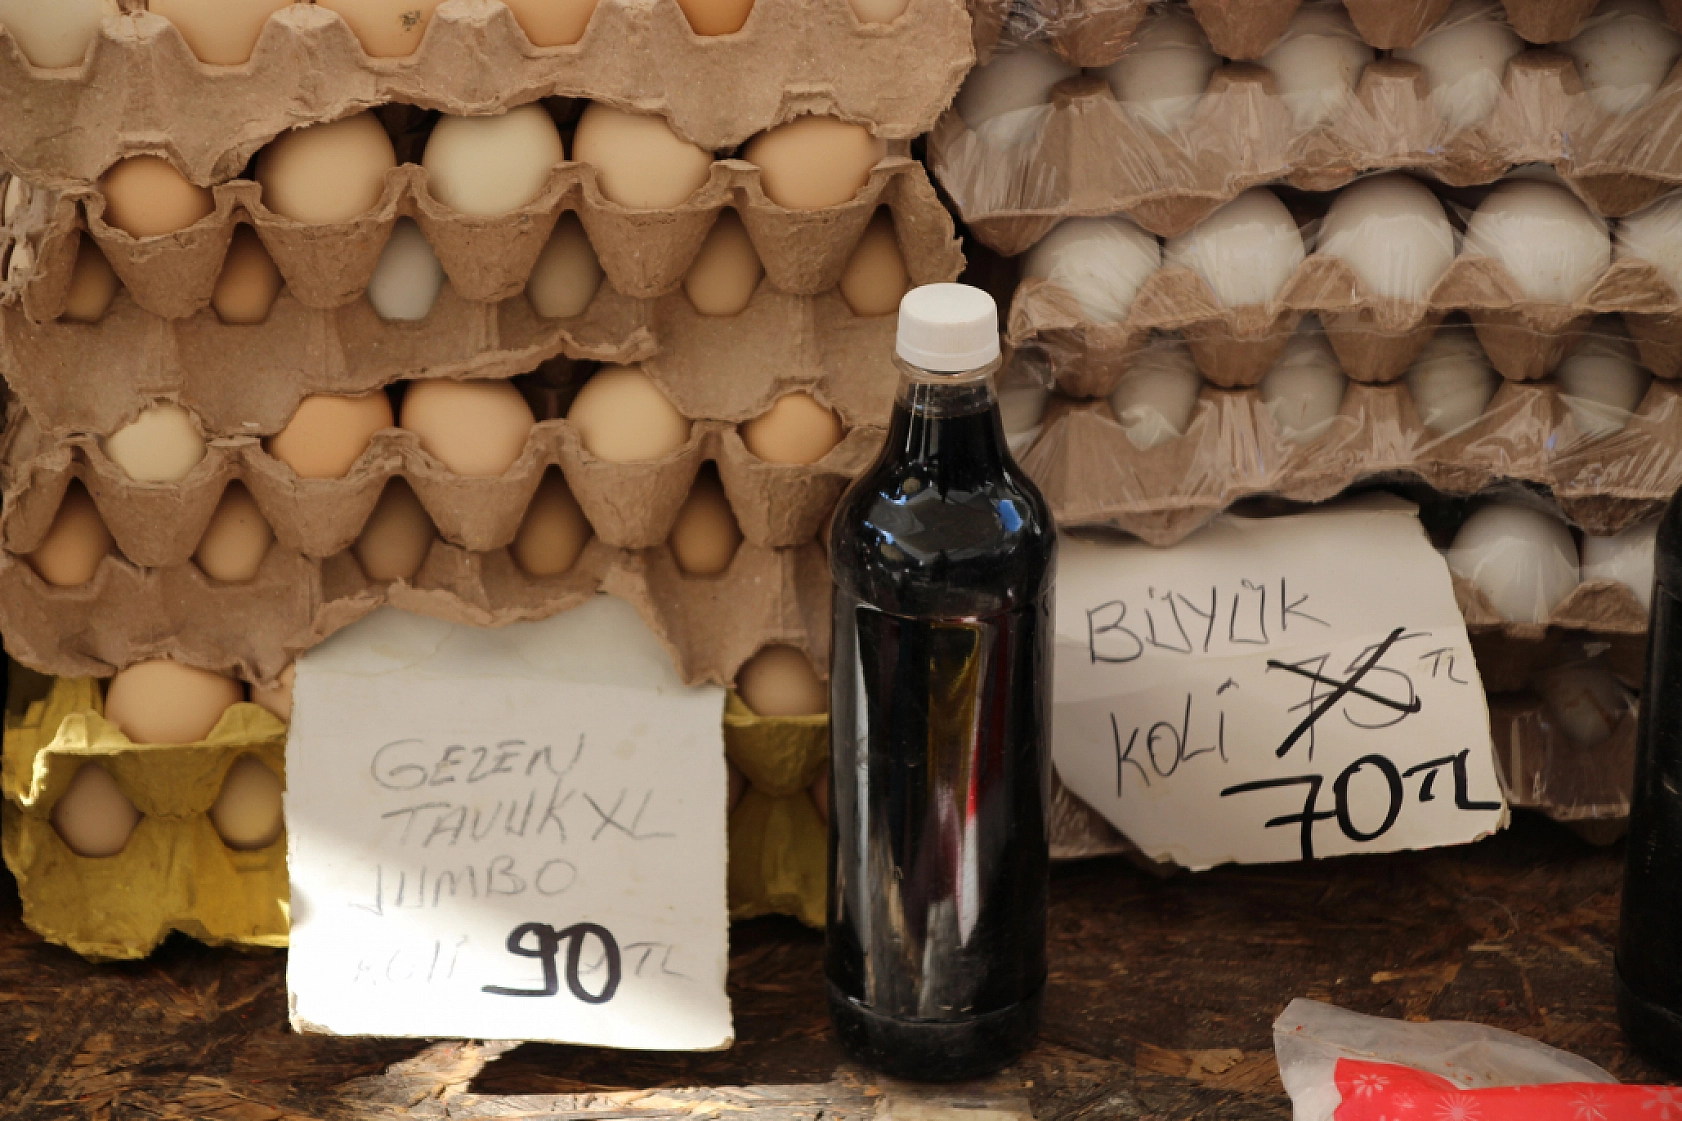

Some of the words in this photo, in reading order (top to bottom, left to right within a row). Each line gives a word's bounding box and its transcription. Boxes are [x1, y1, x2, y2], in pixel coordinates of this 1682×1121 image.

[1087, 577, 1331, 664] BÜYÜK
[371, 732, 585, 791] GEZEN
[381, 777, 576, 848] TAVUK
[582, 788, 676, 841] XL
[348, 855, 578, 916] JUMBO
